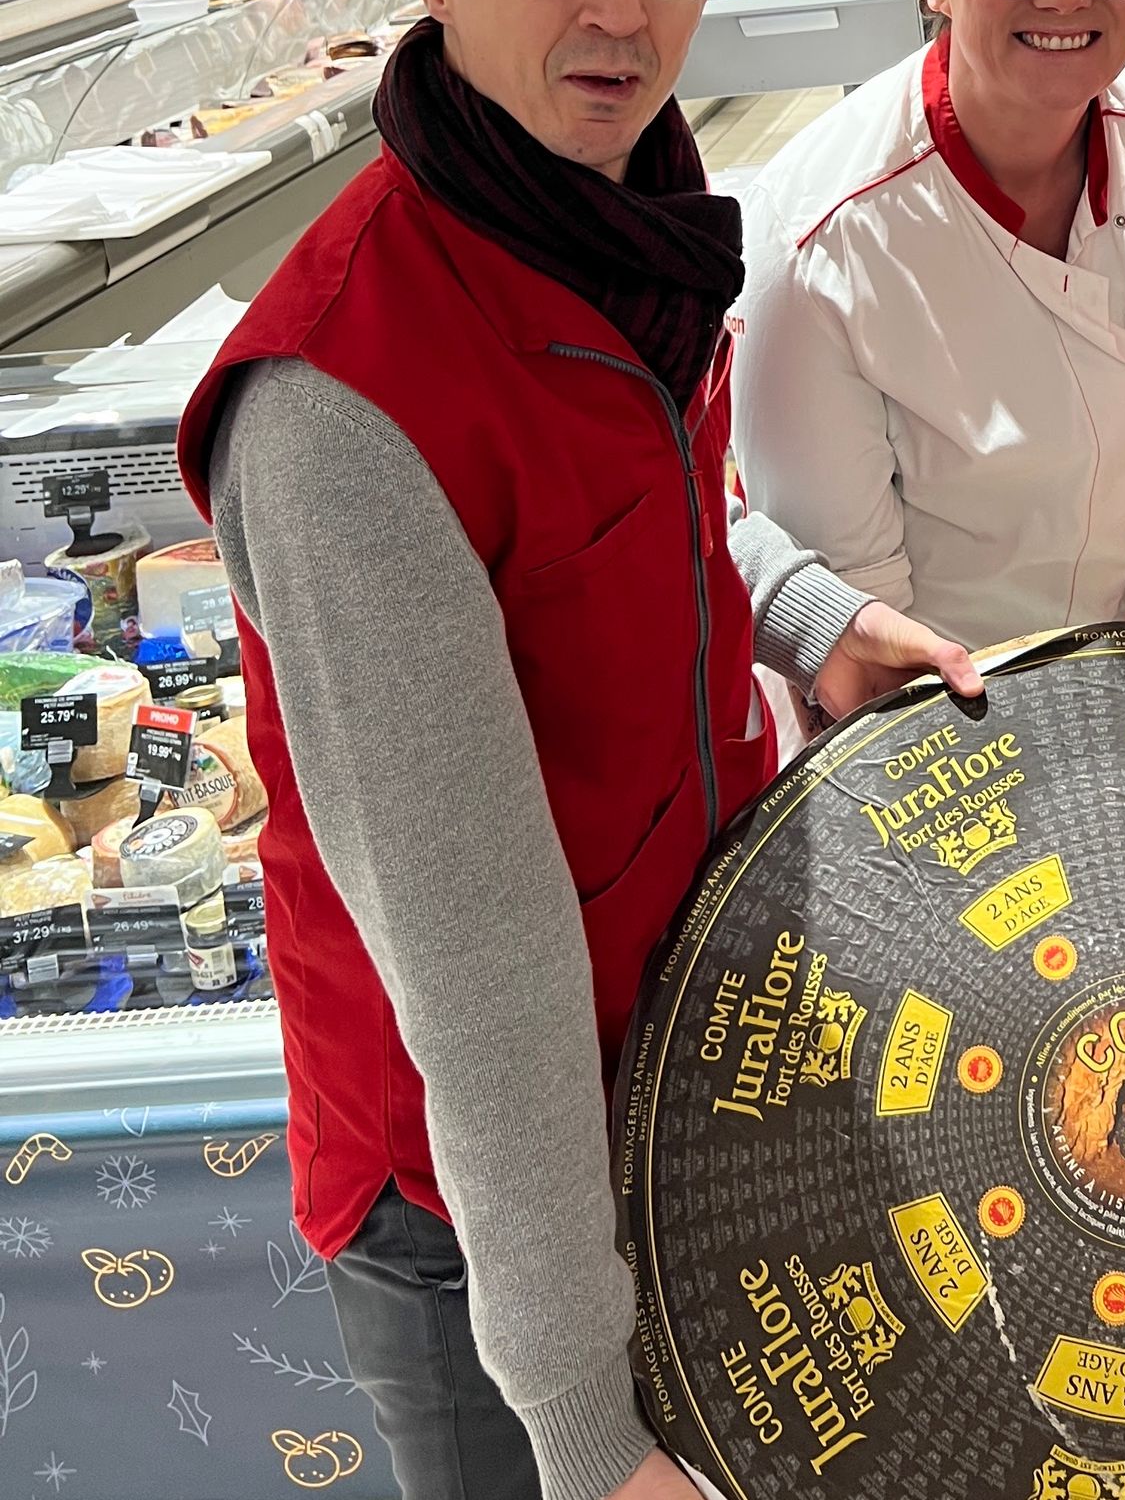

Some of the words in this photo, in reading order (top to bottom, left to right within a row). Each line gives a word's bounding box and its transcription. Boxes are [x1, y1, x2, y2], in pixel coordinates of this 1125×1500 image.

[150, 711, 179, 725] PROMO
[884, 724, 962, 780] COMTE
[194, 773, 236, 800] BASQUE
[859, 732, 1022, 849] JuraFlore
[896, 823, 936, 853] Fort
[933, 808, 964, 834] des
[958, 768, 1025, 815] Rousses
[658, 887, 711, 984] FROMAGERIES
[706, 839, 742, 891] ARNAUD
[986, 902, 998, 920] 2
[998, 874, 1043, 911] ANS
[1004, 895, 1051, 932] D'ÂGE
[700, 969, 746, 1062] COMTE
[789, 952, 828, 1030] Rousses
[712, 930, 806, 1122] JuraFlore
[780, 1031, 806, 1067] des
[893, 1019, 921, 1066] ANS
[890, 1075, 908, 1090] 2
[914, 1029, 940, 1087] D'ÂGE
[766, 1070, 792, 1107] Fort
[1051, 1124, 1087, 1181] AFFINÉ
[909, 1226, 950, 1280] ANS
[933, 1218, 973, 1278] D'ÂGE
[784, 1253, 833, 1341] Rousses
[938, 1282, 960, 1300] 2
[738, 1259, 868, 1476] JuraFlore
[824, 1332, 853, 1371] des
[720, 1340, 783, 1445] COMTE
[842, 1368, 876, 1421] Fort
[1065, 1373, 1119, 1405] ANS
